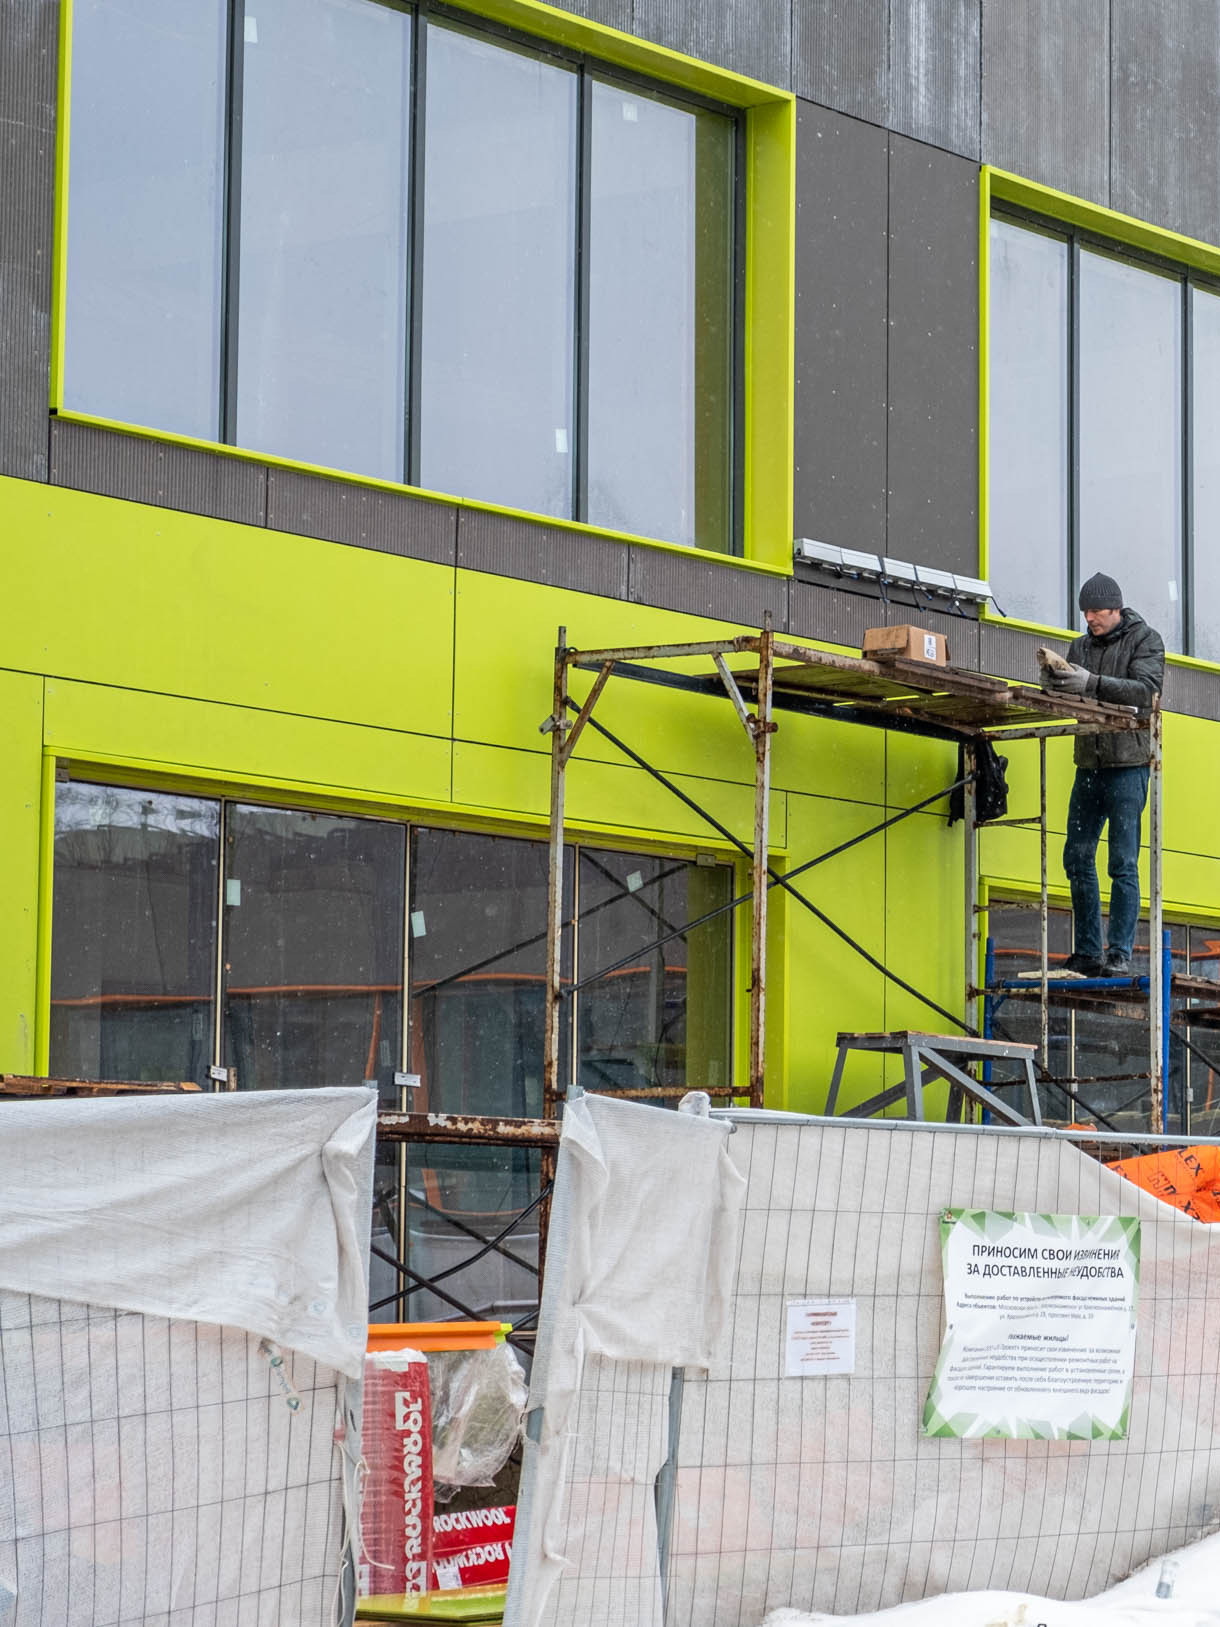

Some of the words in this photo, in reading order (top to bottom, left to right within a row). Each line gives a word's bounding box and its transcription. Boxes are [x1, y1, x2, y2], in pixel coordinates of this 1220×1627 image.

[973, 1244, 1038, 1260] ПРИНОСИМ
[1041, 1248, 1072, 1261] СВОИ
[966, 1263, 980, 1276] ЗА
[433, 1507, 511, 1533] ROCKWOOL
